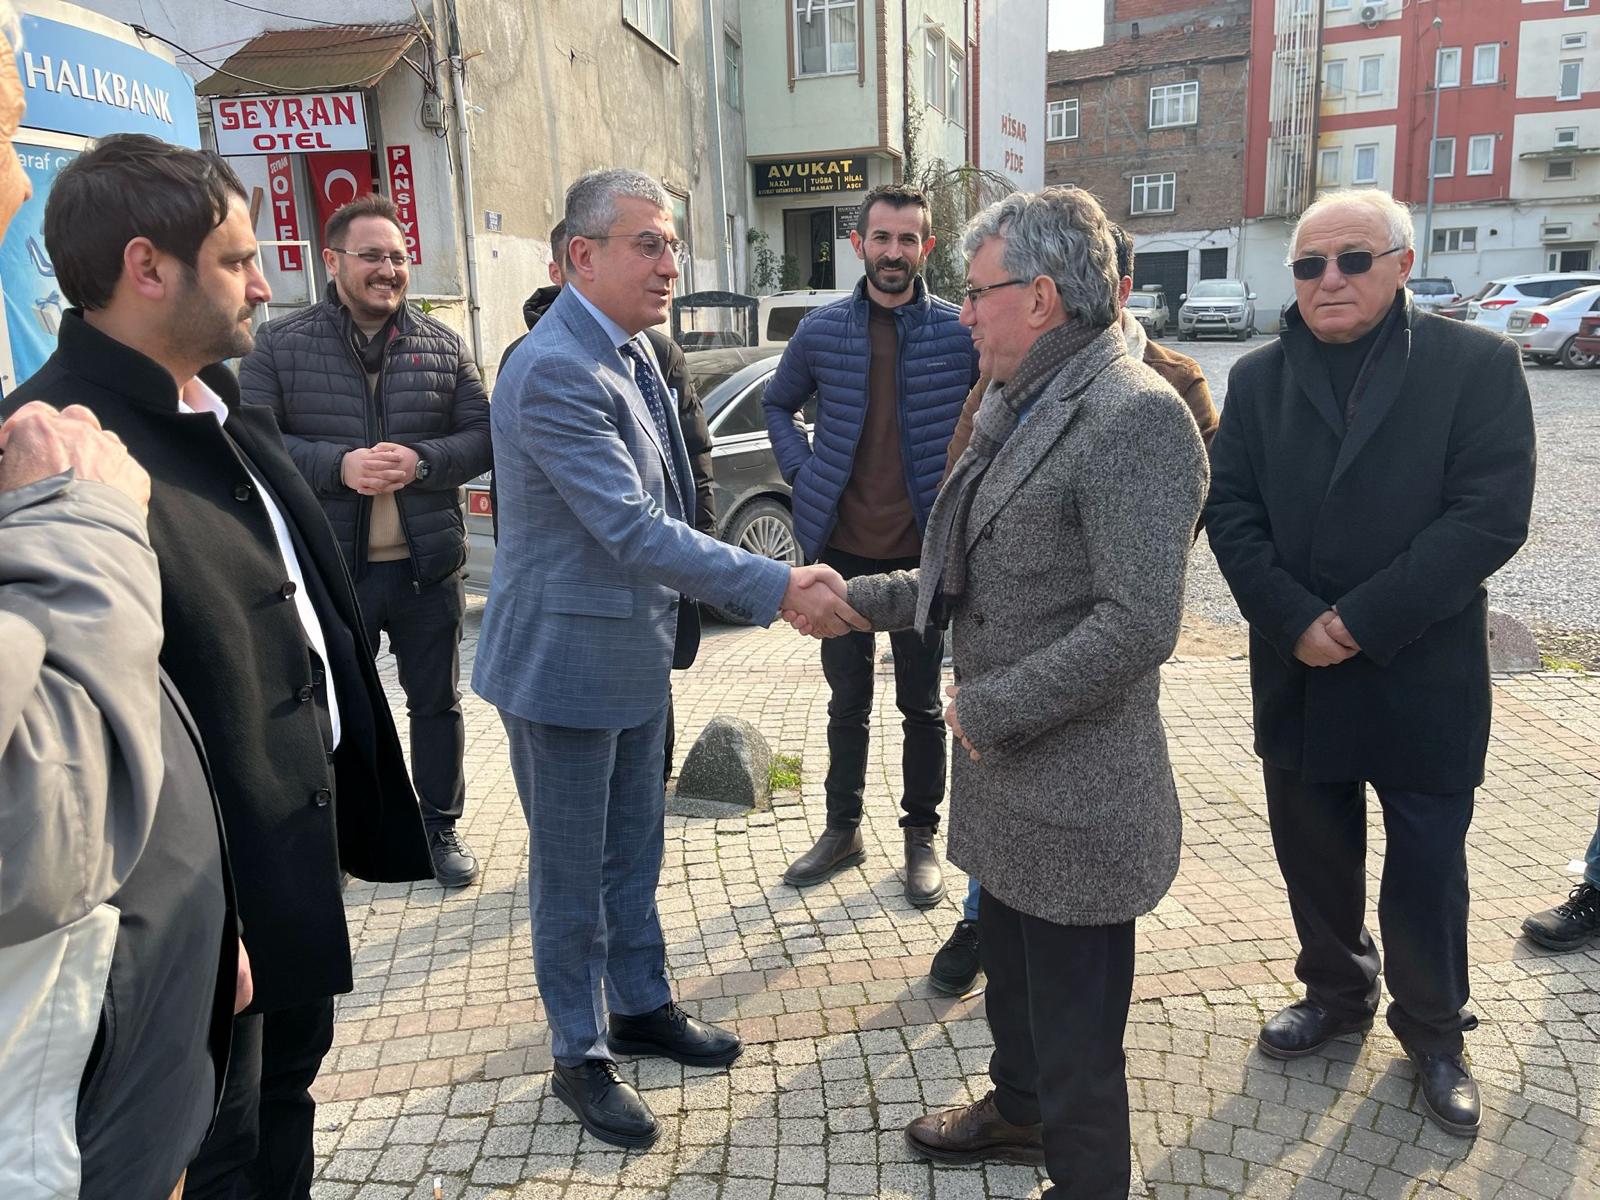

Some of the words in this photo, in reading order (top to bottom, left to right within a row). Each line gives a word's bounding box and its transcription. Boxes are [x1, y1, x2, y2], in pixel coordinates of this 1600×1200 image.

[23, 52, 172, 124] HALKBANK
[219, 96, 357, 130] SEYRAN
[1001, 112, 1027, 143] HİSAR
[253, 132, 331, 150] OTEL
[18, 152, 51, 171] araf
[768, 160, 853, 178] AVUKAT
[1004, 147, 1024, 174] PİDE
[272, 175, 297, 269] OTEL
